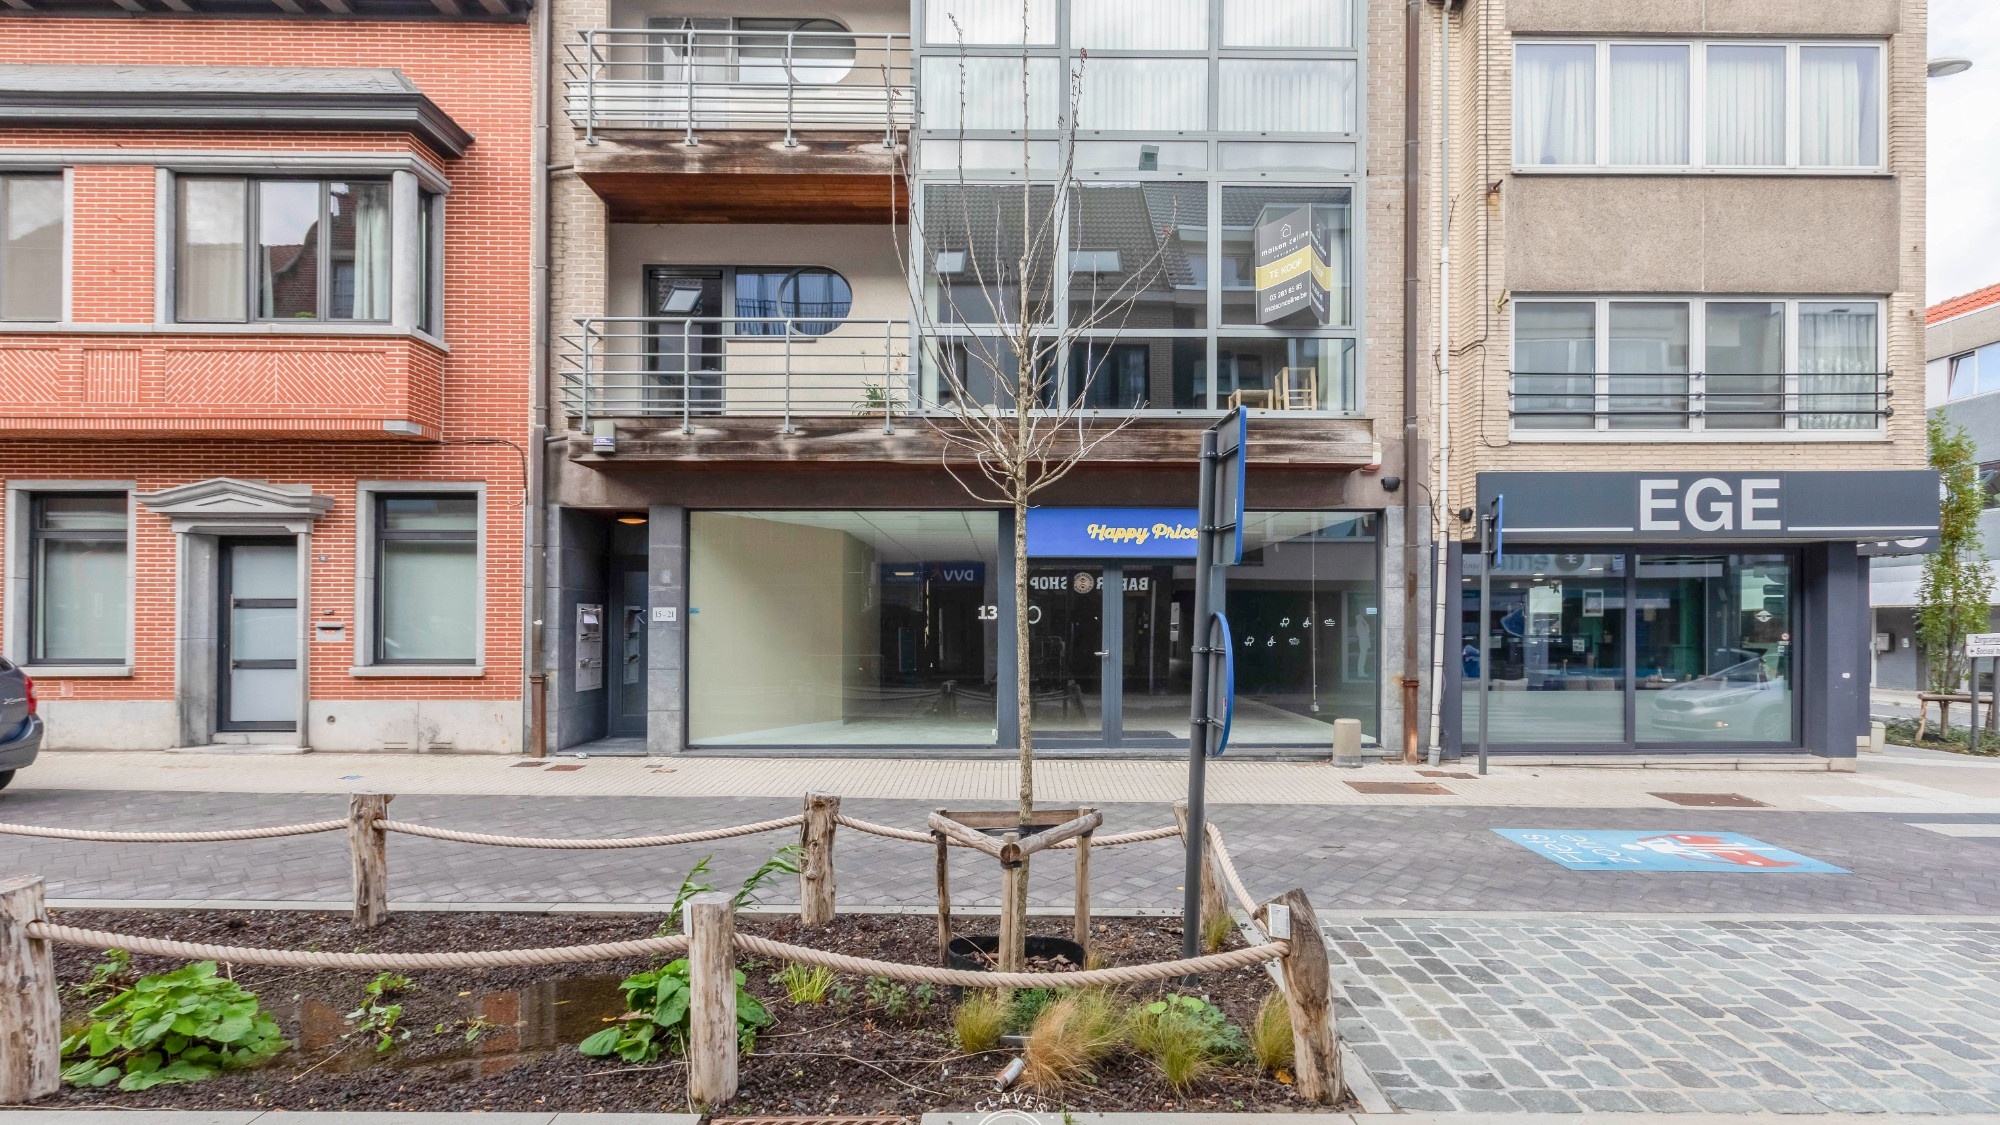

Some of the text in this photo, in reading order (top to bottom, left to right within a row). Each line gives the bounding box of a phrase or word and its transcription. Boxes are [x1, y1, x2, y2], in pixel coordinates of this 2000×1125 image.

[1262, 242, 1287, 257] maison
[1289, 230, 1309, 245] celine
[1269, 269, 1280, 280] TE
[1281, 258, 1303, 274] KOOP
[1640, 478, 1781, 532] EGE
[1087, 523, 1150, 545] Happy
[655, 610, 662, 618] 15
[667, 610, 674, 618] 21
[977, 605, 998, 620] 13
[1522, 834, 1602, 863] Fiets
